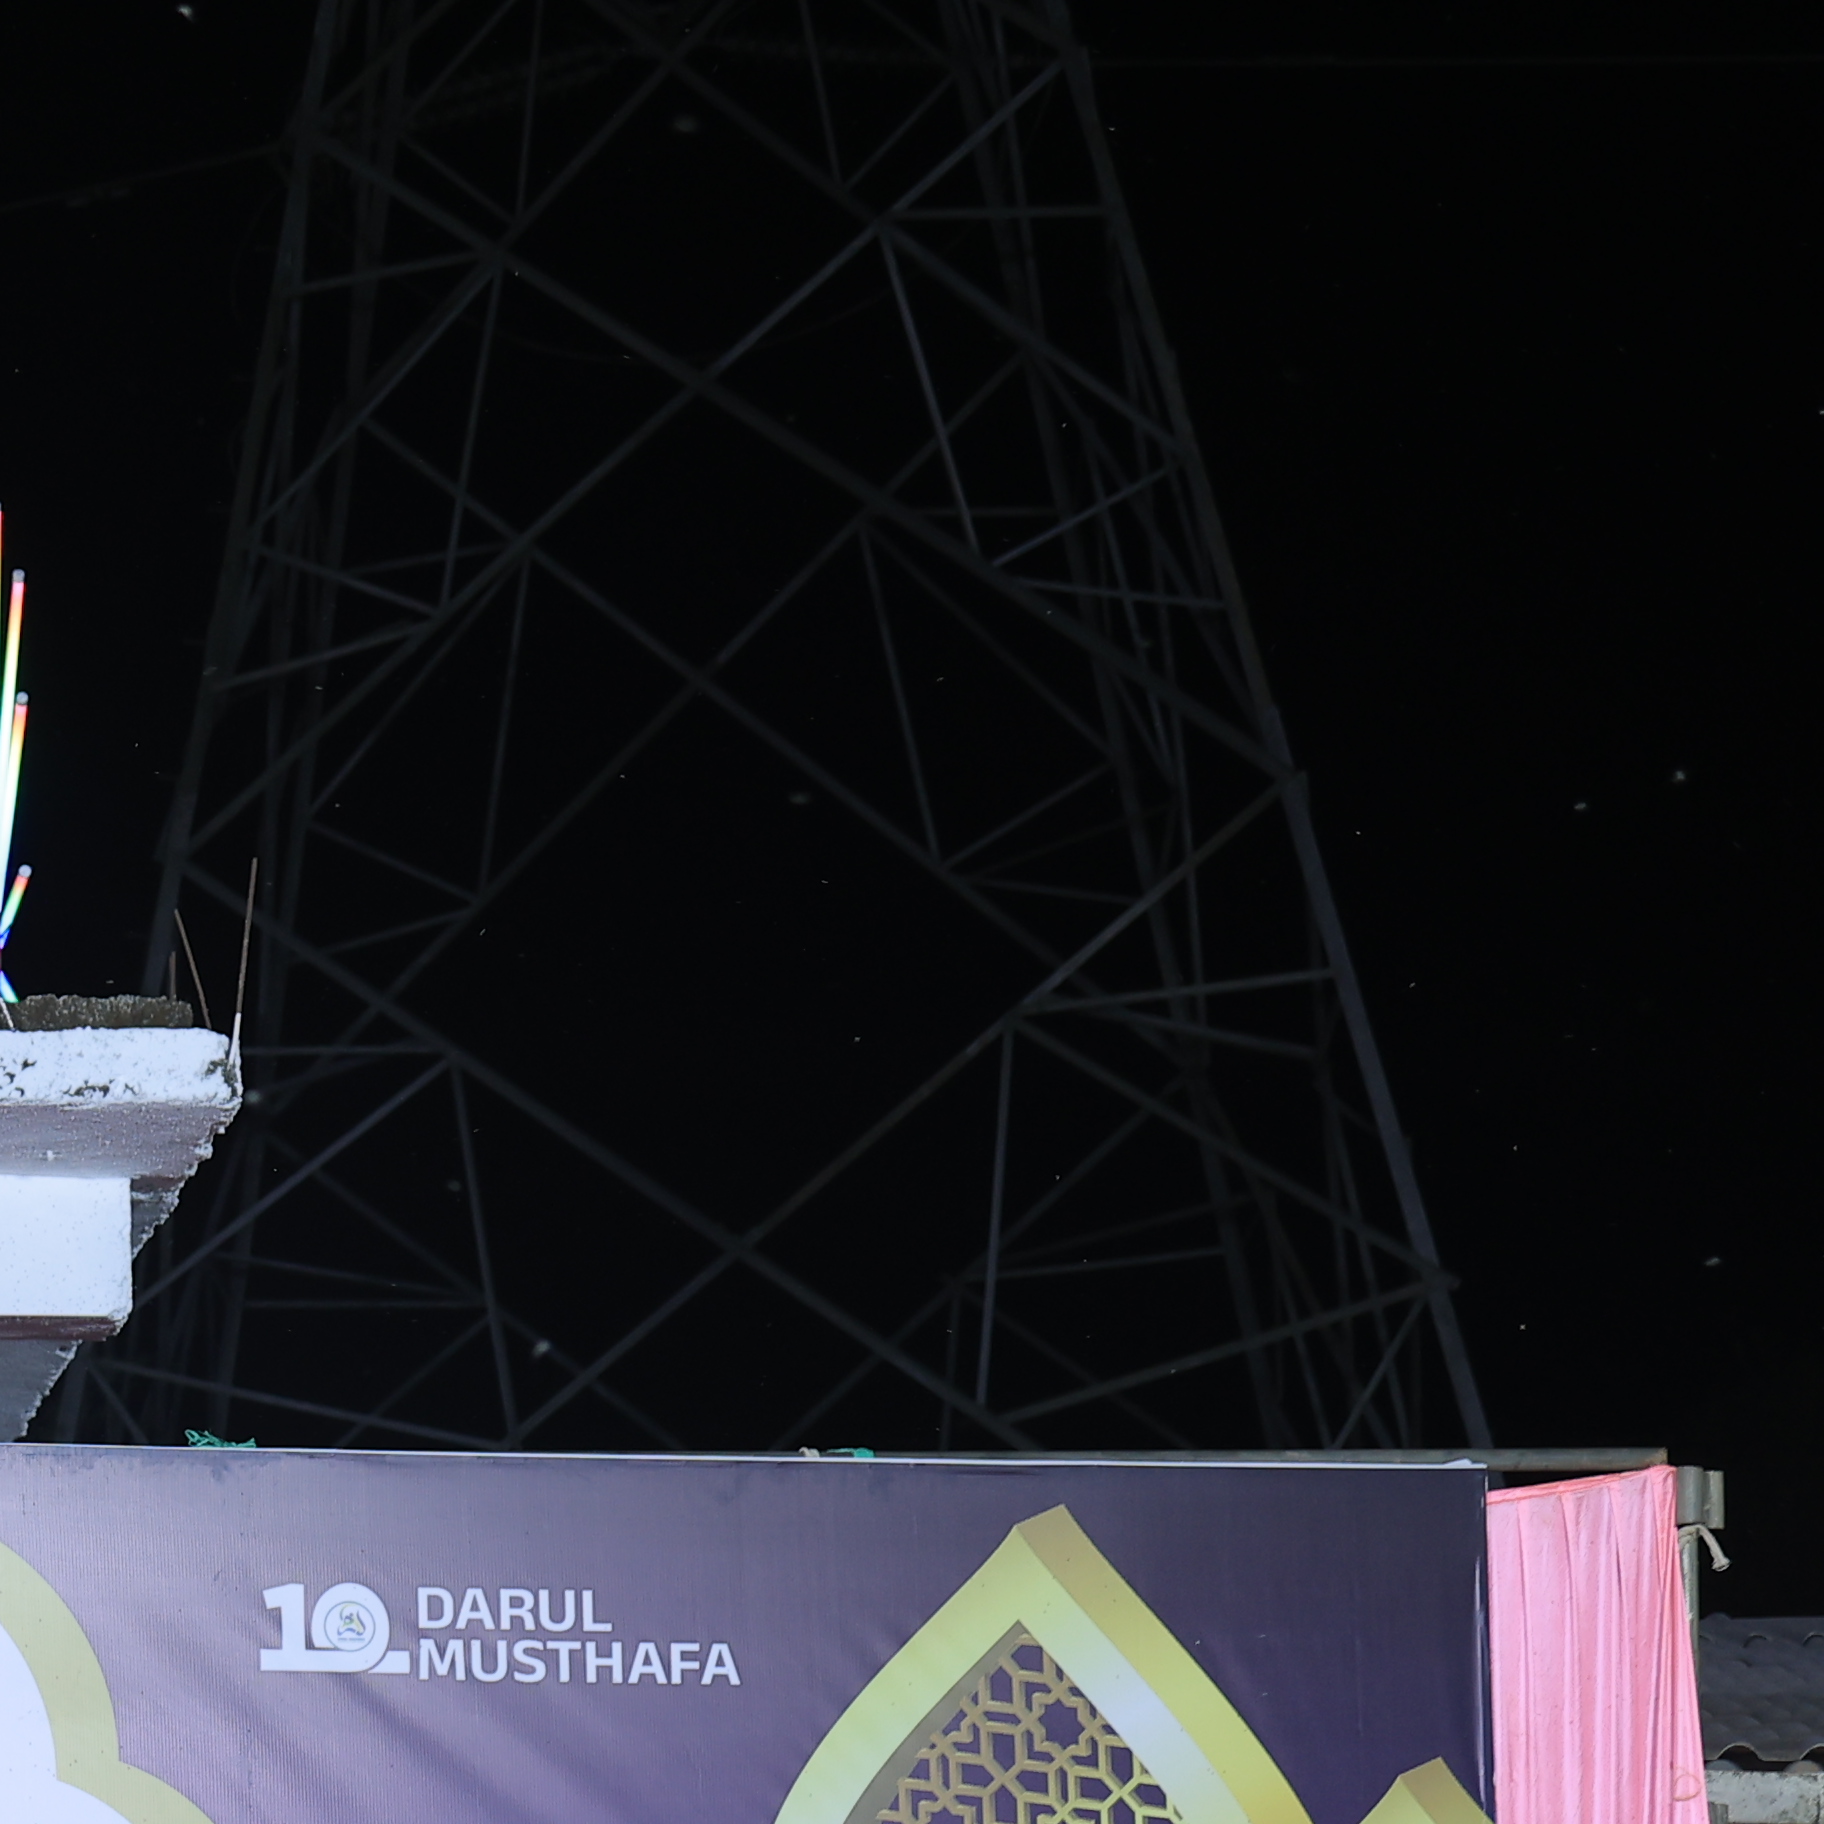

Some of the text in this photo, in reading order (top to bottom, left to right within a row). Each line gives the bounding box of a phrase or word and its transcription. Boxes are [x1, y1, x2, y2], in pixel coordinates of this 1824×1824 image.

[259, 1582, 411, 1674] 10
[416, 1586, 614, 1633] DARUL
[417, 1637, 743, 1687] MUSTHAFA
